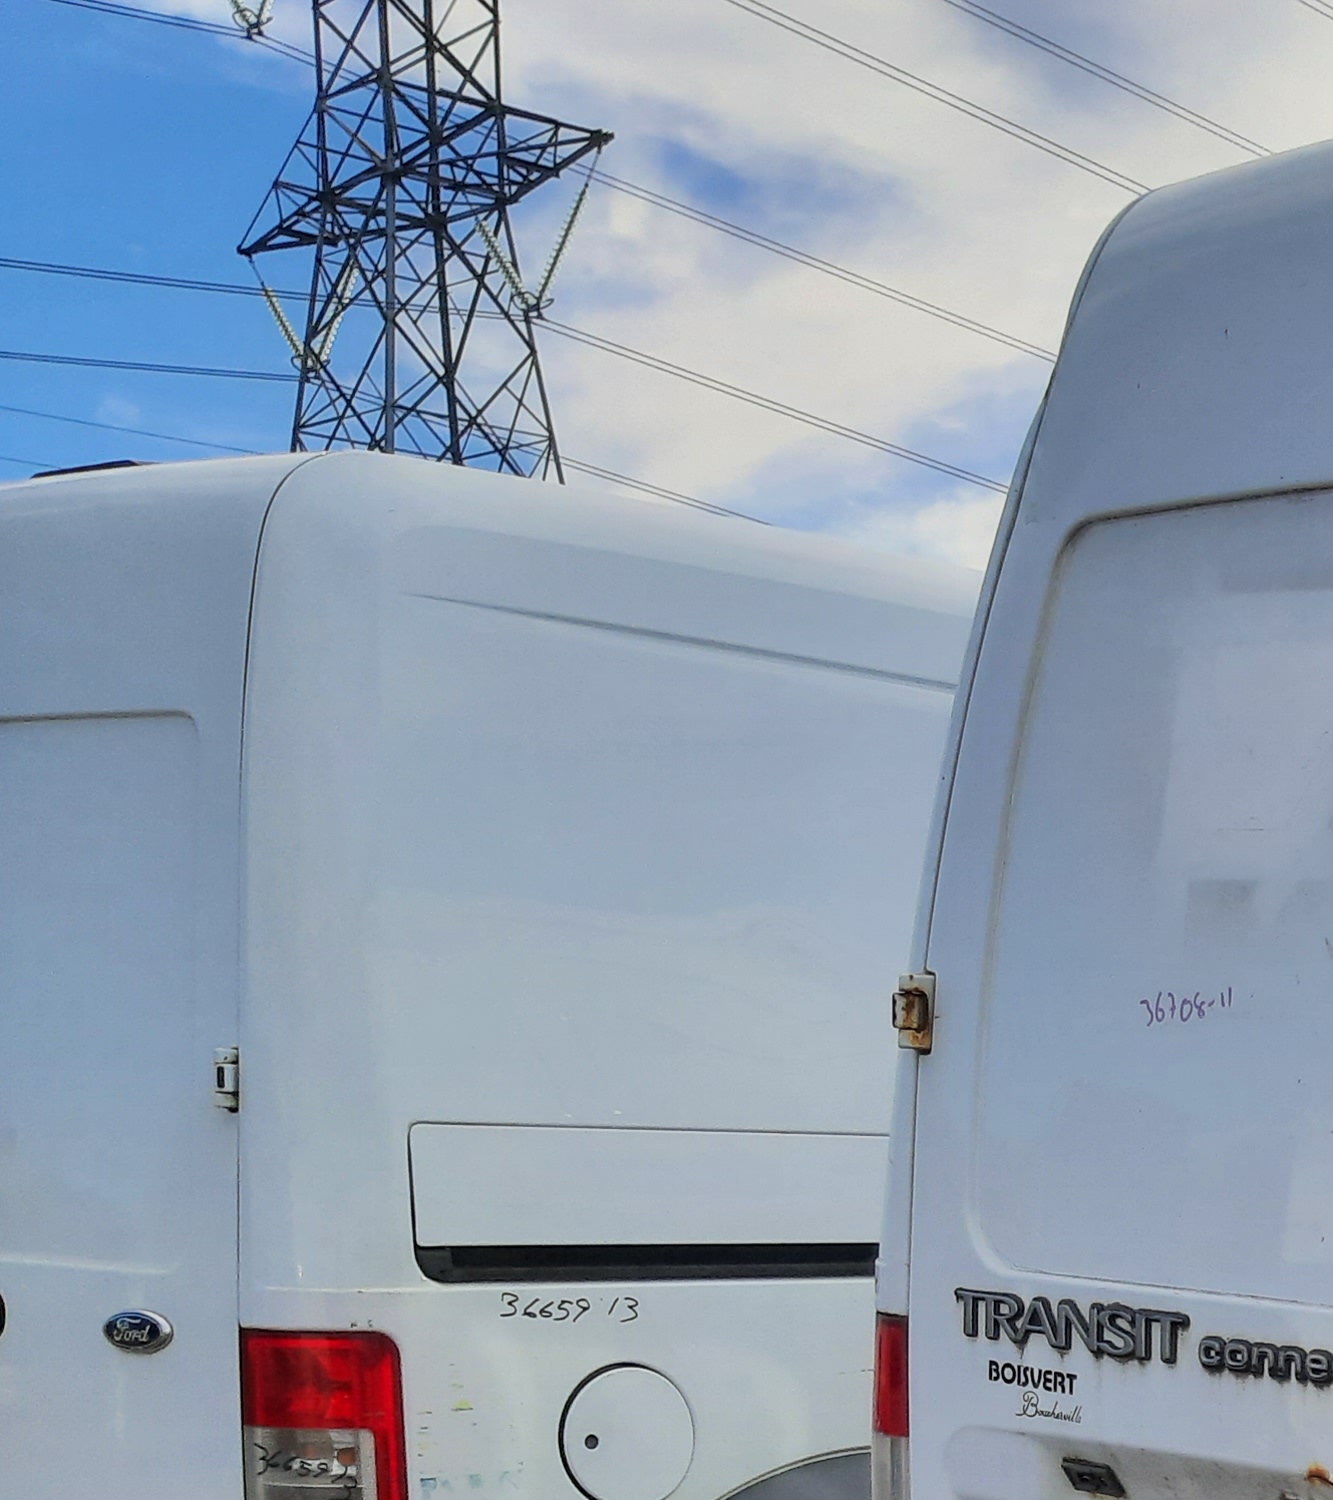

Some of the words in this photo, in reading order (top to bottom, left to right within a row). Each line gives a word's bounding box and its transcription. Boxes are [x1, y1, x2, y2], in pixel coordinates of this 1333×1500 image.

[1139, 986, 1233, 1028] 36708-11
[500, 1292, 591, 1323] 36659
[113, 1316, 152, 1343] Ford
[954, 1287, 1191, 1365] TRANSIT
[987, 1360, 1078, 1396] BOISVERT
